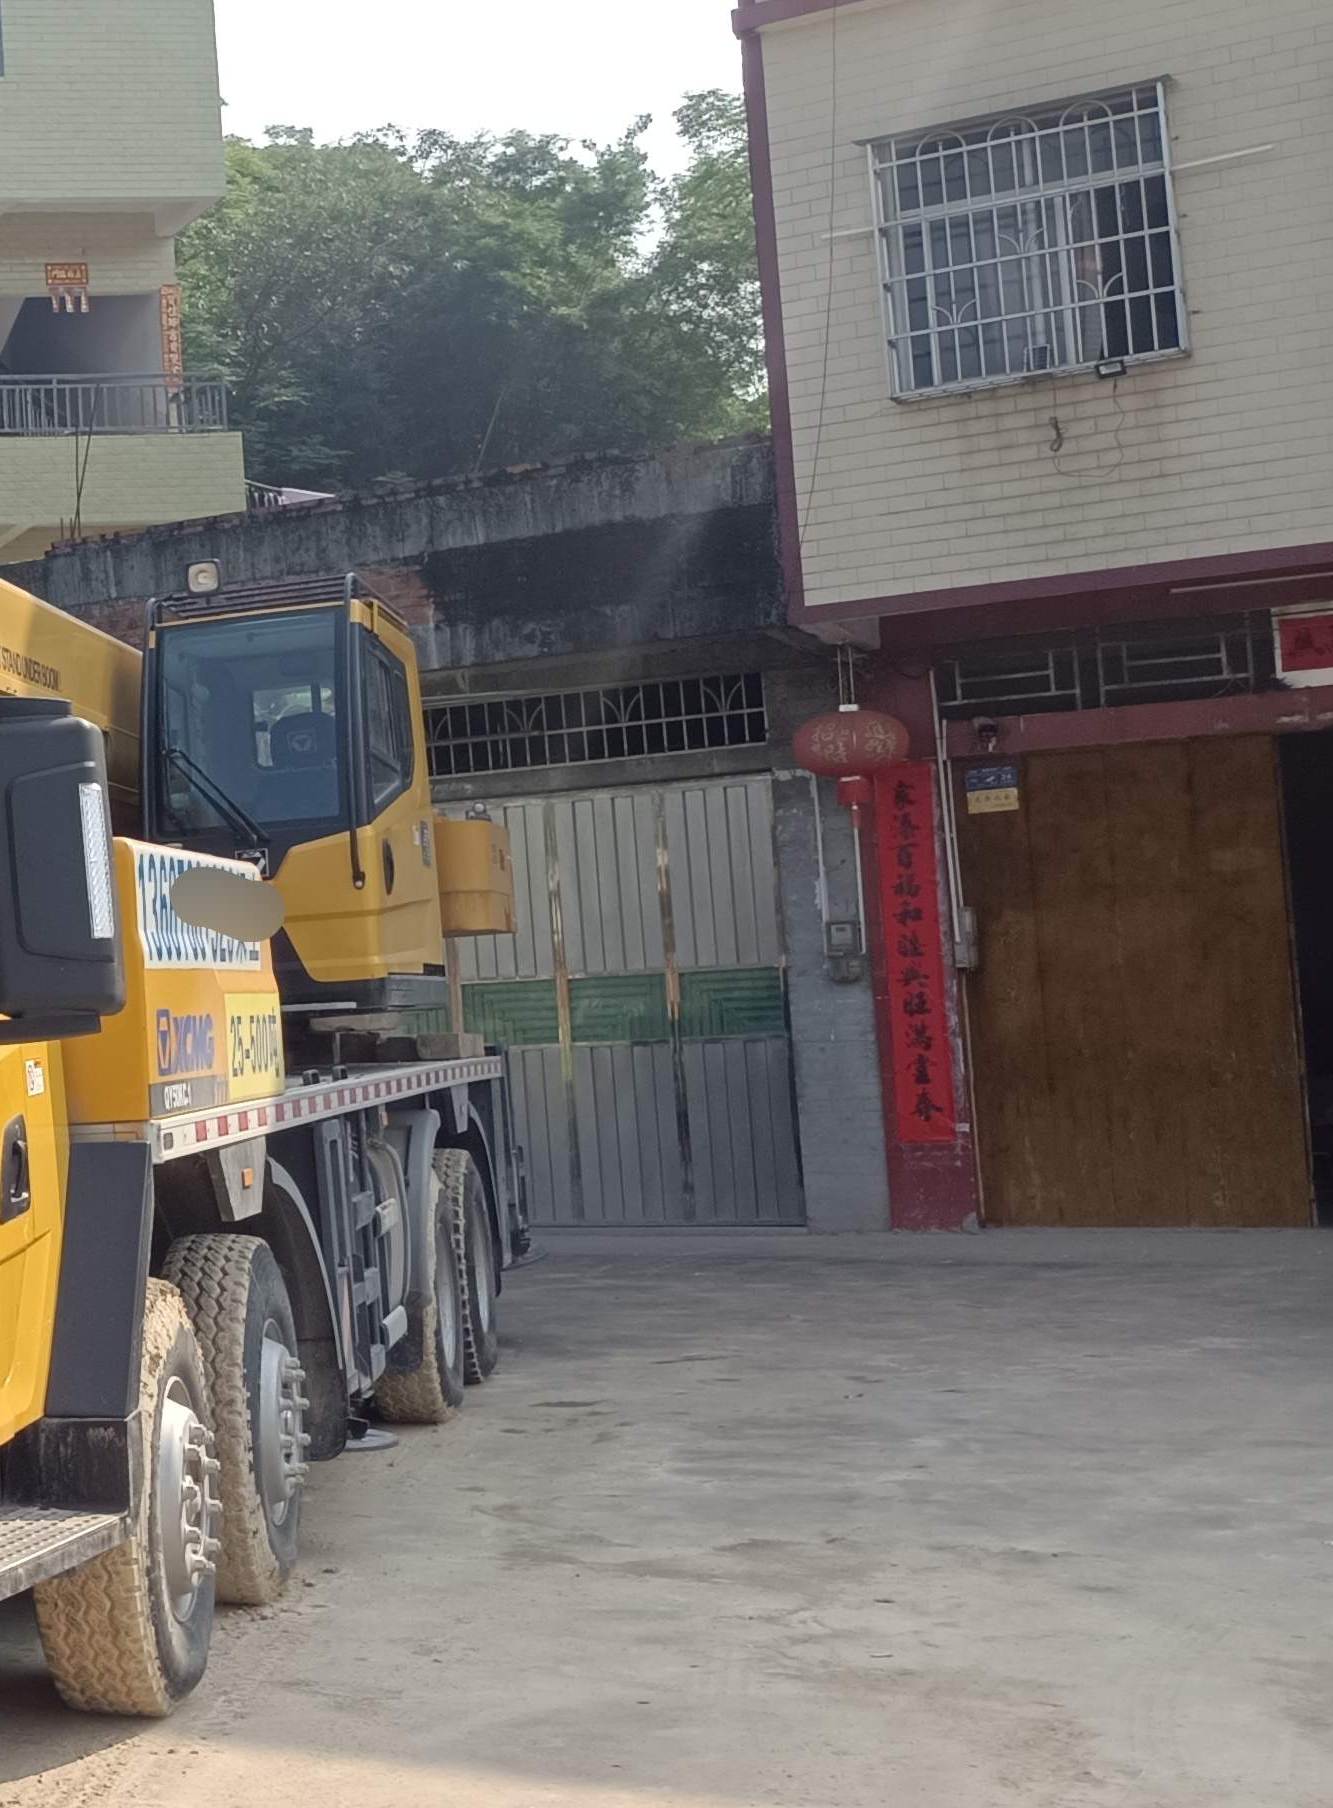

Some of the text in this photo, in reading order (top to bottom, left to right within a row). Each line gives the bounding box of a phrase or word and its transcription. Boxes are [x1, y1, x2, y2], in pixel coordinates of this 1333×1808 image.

[1, 646, 22, 677] STAND
[22, 654, 41, 685] UNDER
[171, 1013, 214, 1074] XCMG
